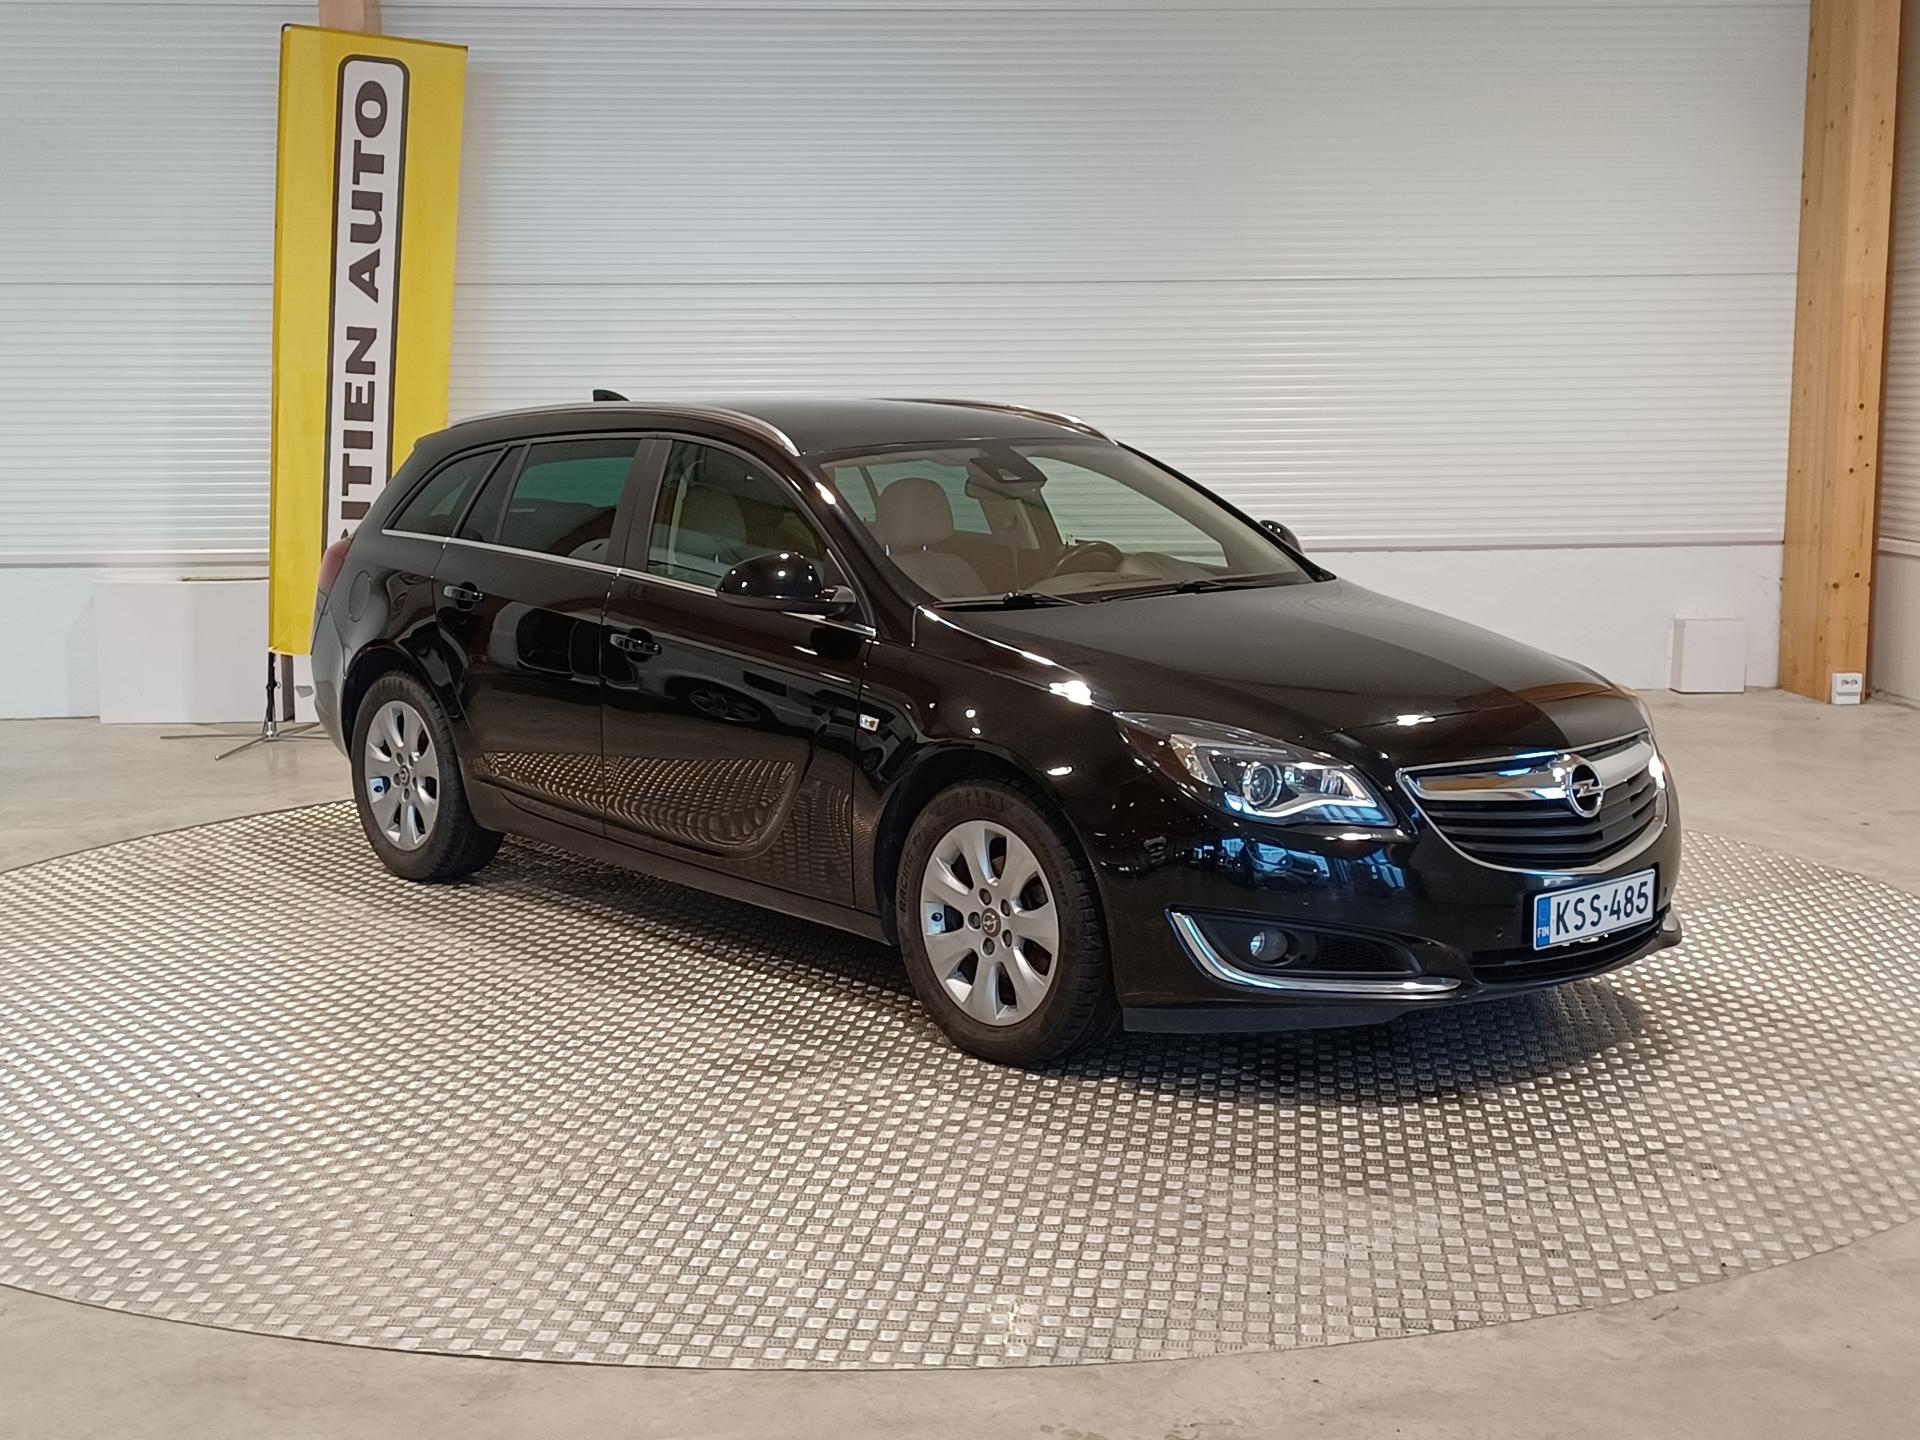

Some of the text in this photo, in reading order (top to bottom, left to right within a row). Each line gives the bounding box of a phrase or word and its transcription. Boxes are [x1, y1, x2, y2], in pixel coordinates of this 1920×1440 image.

[349, 80, 388, 304] AUTO
[1537, 880, 1649, 939] FIN KSS-485
